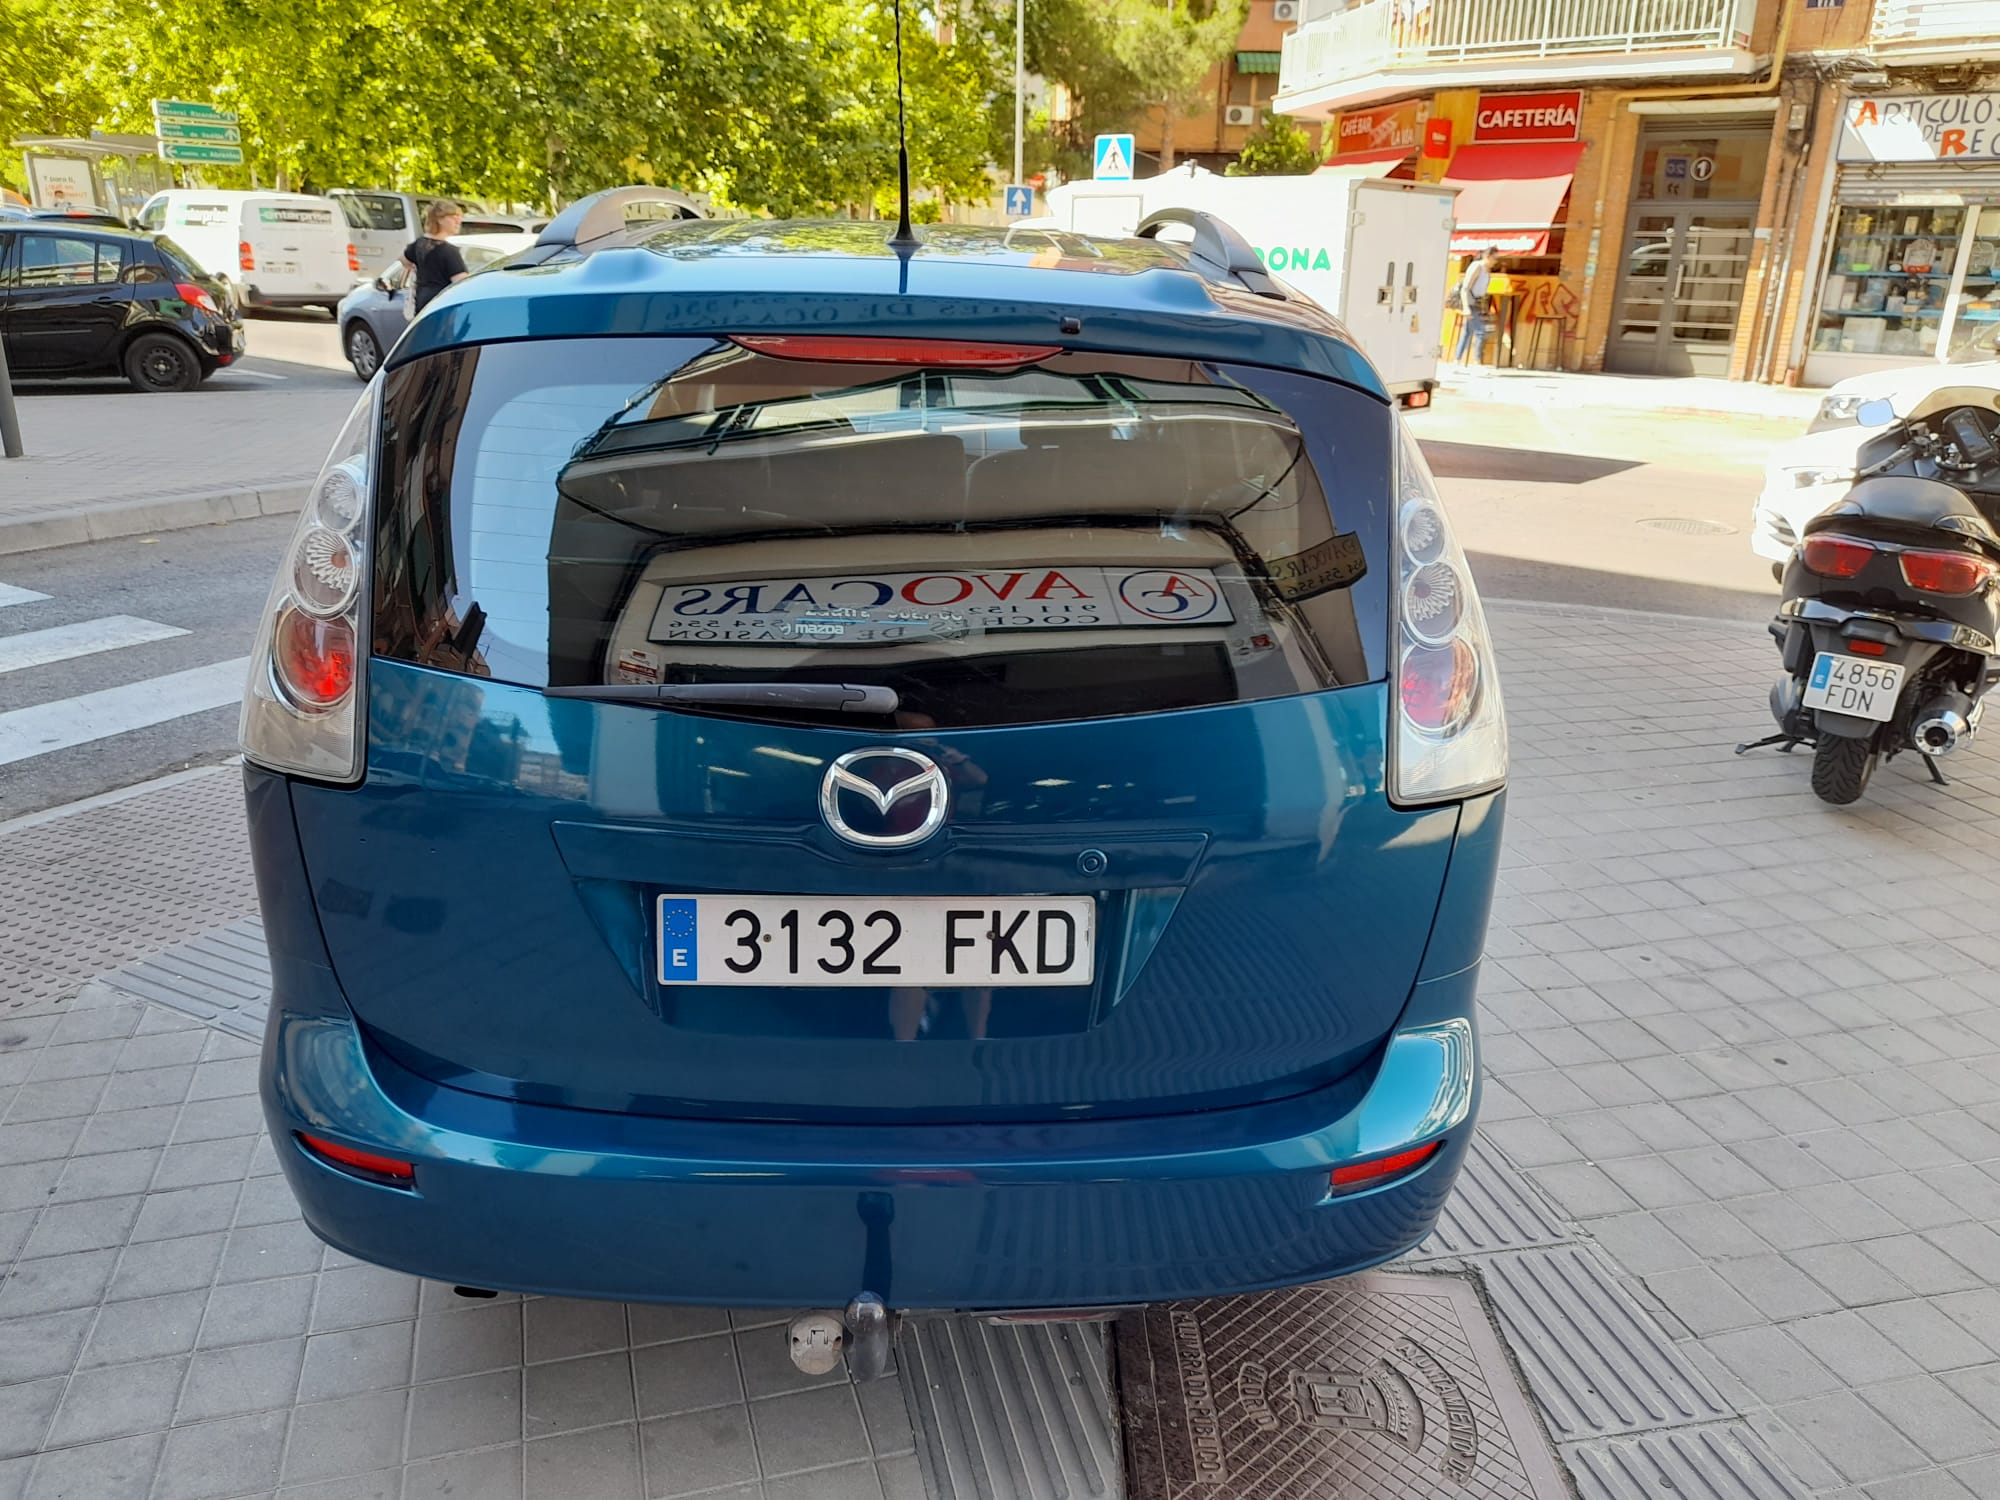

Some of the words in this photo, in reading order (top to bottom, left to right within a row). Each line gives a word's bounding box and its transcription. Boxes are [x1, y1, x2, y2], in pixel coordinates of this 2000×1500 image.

[1477, 102, 1577, 129] CAFETERÍA
[1833, 660, 1897, 691] 4856
[1825, 684, 1874, 713] FDN
[672, 948, 688, 967] E
[723, 908, 902, 975] 3132
[945, 909, 1076, 975] FKD
[1175, 1314, 1209, 1397] ALUMBRADO
[1239, 1364, 1275, 1424] MADRID
[1397, 1343, 1476, 1452] AYUNTAMIENTO
[1440, 1457, 1470, 1484] DE
